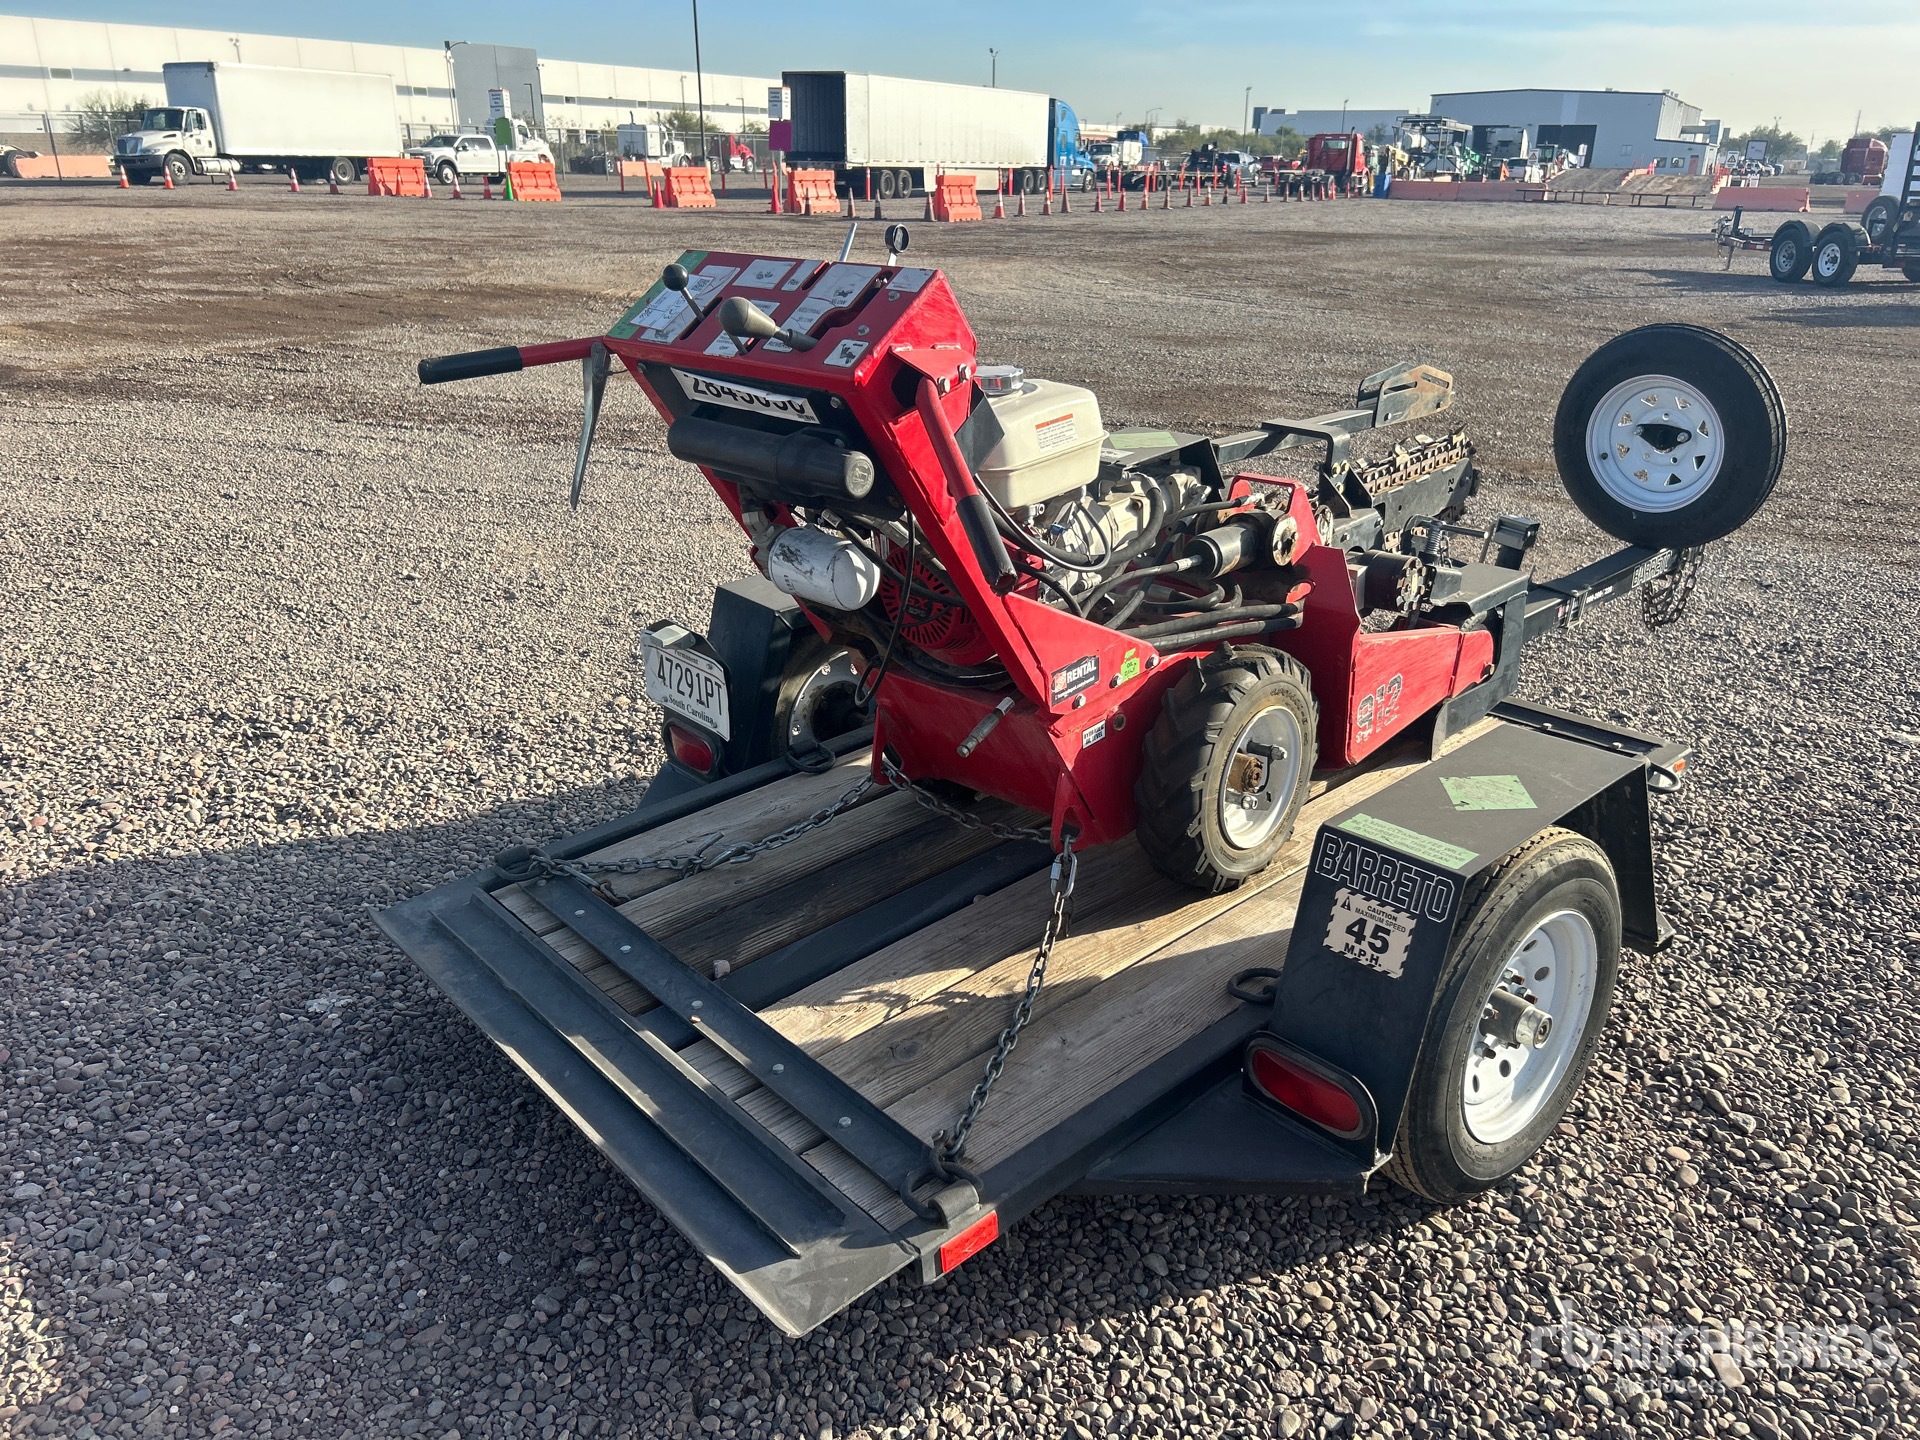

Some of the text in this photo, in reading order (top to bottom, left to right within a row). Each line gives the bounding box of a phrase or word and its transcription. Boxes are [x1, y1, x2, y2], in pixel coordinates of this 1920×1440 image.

[1631, 549, 1674, 589] BARRETO
[657, 654, 722, 716] 47291PT
[1067, 659, 1097, 684] RENTAL
[668, 693, 715, 725] South Carolina
[1362, 823, 1399, 839] CHARGED
[1428, 846, 1467, 863] MACHINE
[1422, 850, 1451, 863] CLEAN
[1443, 846, 1464, 857] WILL
[1315, 832, 1455, 922] BARRETO
[1355, 907, 1406, 933] MAXIMUM SPEED
[1367, 905, 1398, 922] CAUTION
[1345, 917, 1391, 955] 45
[1344, 942, 1382, 967] M.P.H.
